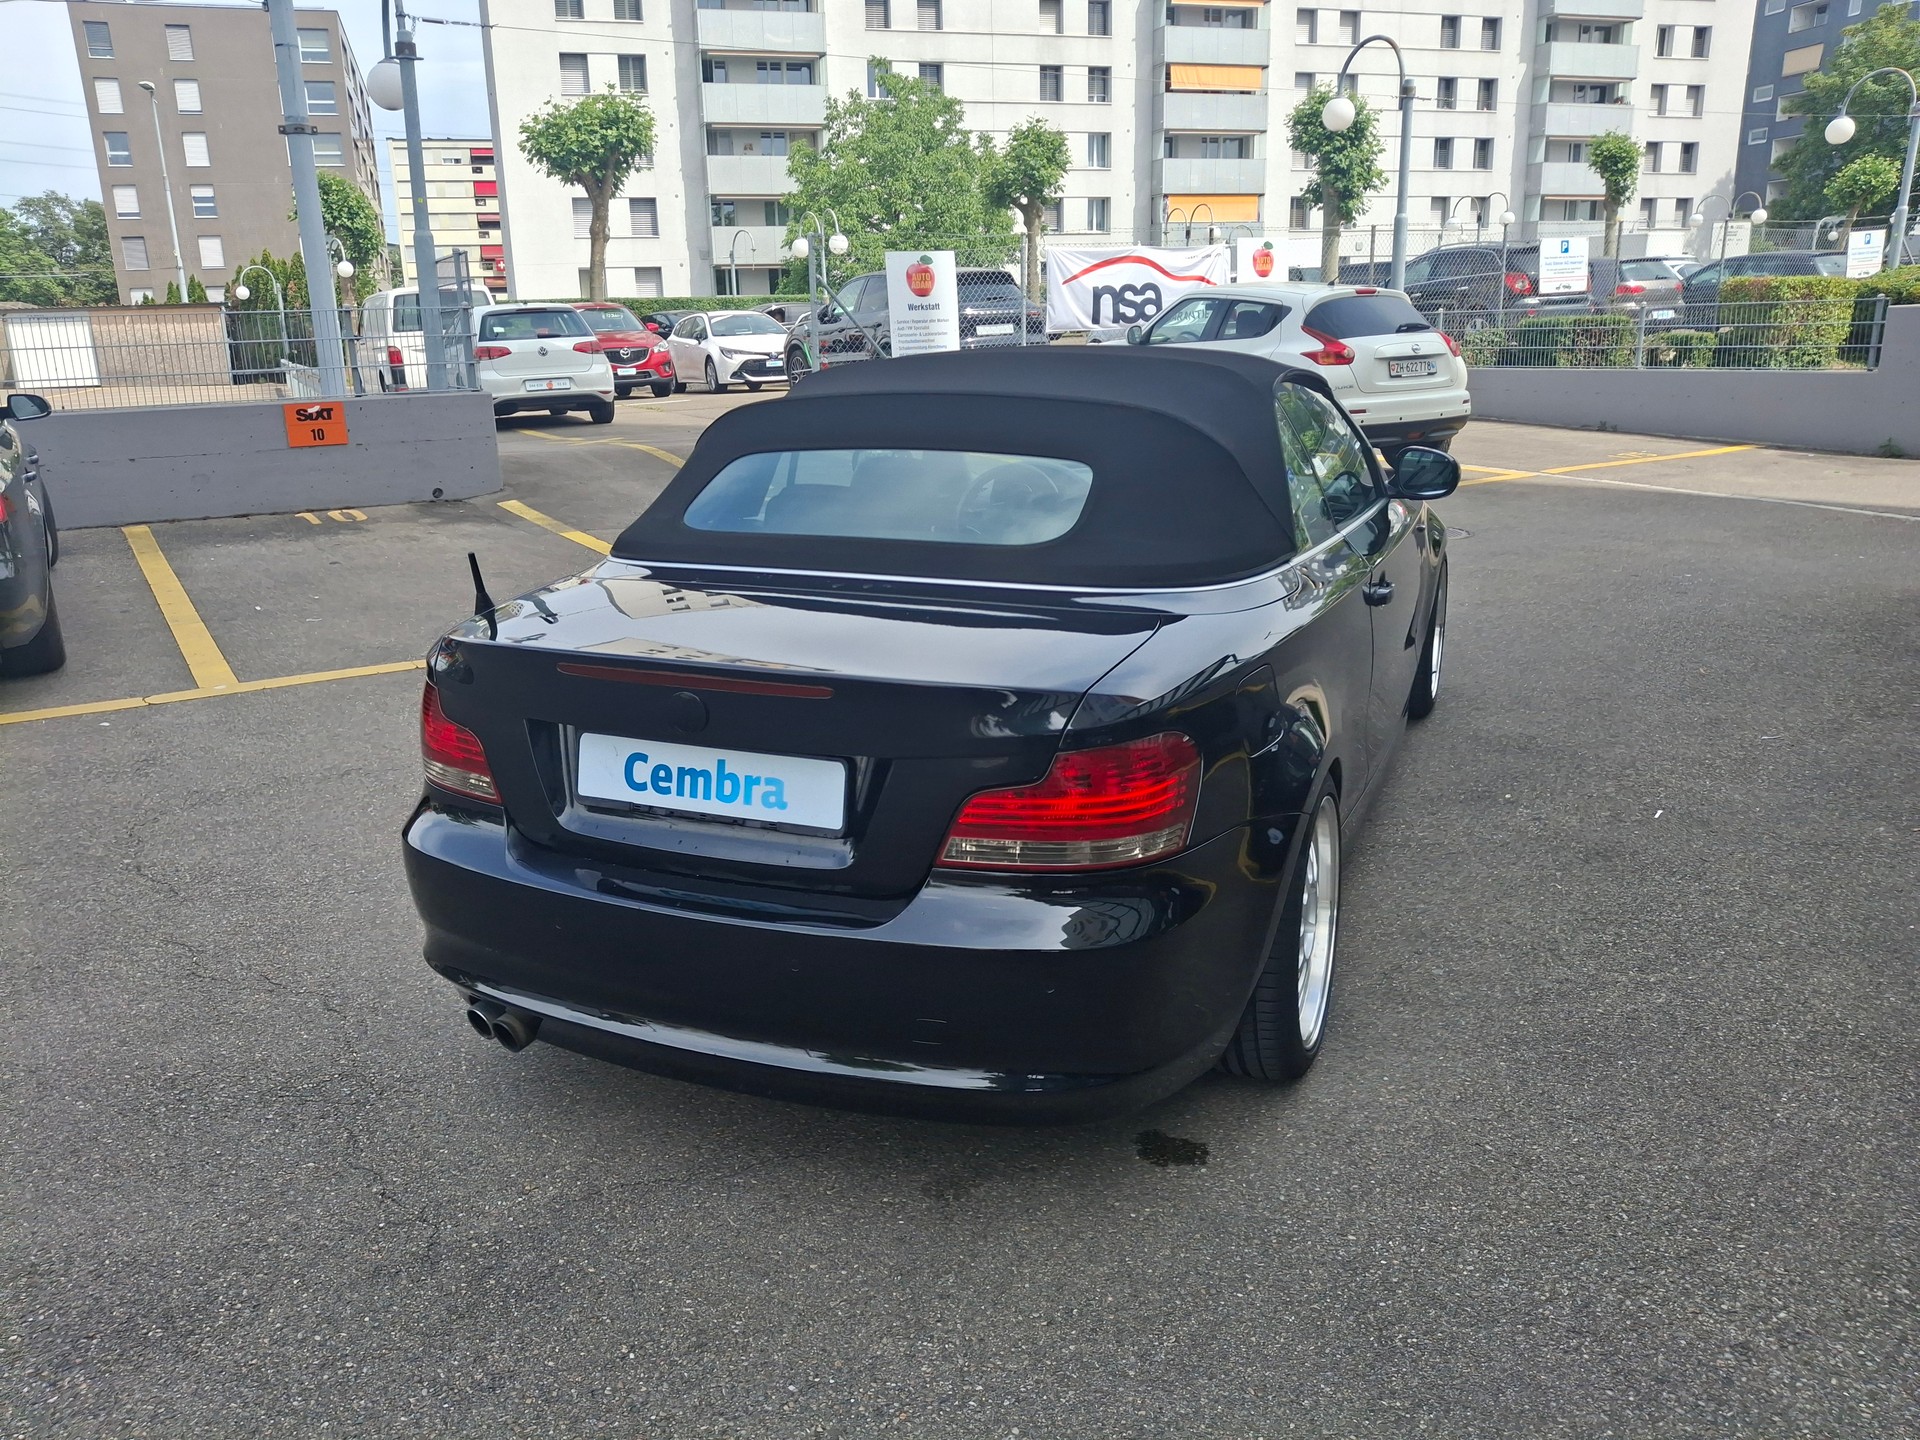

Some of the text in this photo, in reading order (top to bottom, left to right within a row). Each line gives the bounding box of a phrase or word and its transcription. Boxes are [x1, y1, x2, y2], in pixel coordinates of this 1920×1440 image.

[911, 281, 932, 289] ADAM
[907, 303, 940, 311] Werkstatt
[1091, 282, 1163, 325] nsa
[1171, 309, 1210, 321] ARANTIE
[1395, 362, 1405, 373] ZH
[296, 407, 334, 422] SIXT
[310, 428, 325, 441] 10
[294, 509, 369, 525] 10
[624, 751, 788, 811] Cembra
